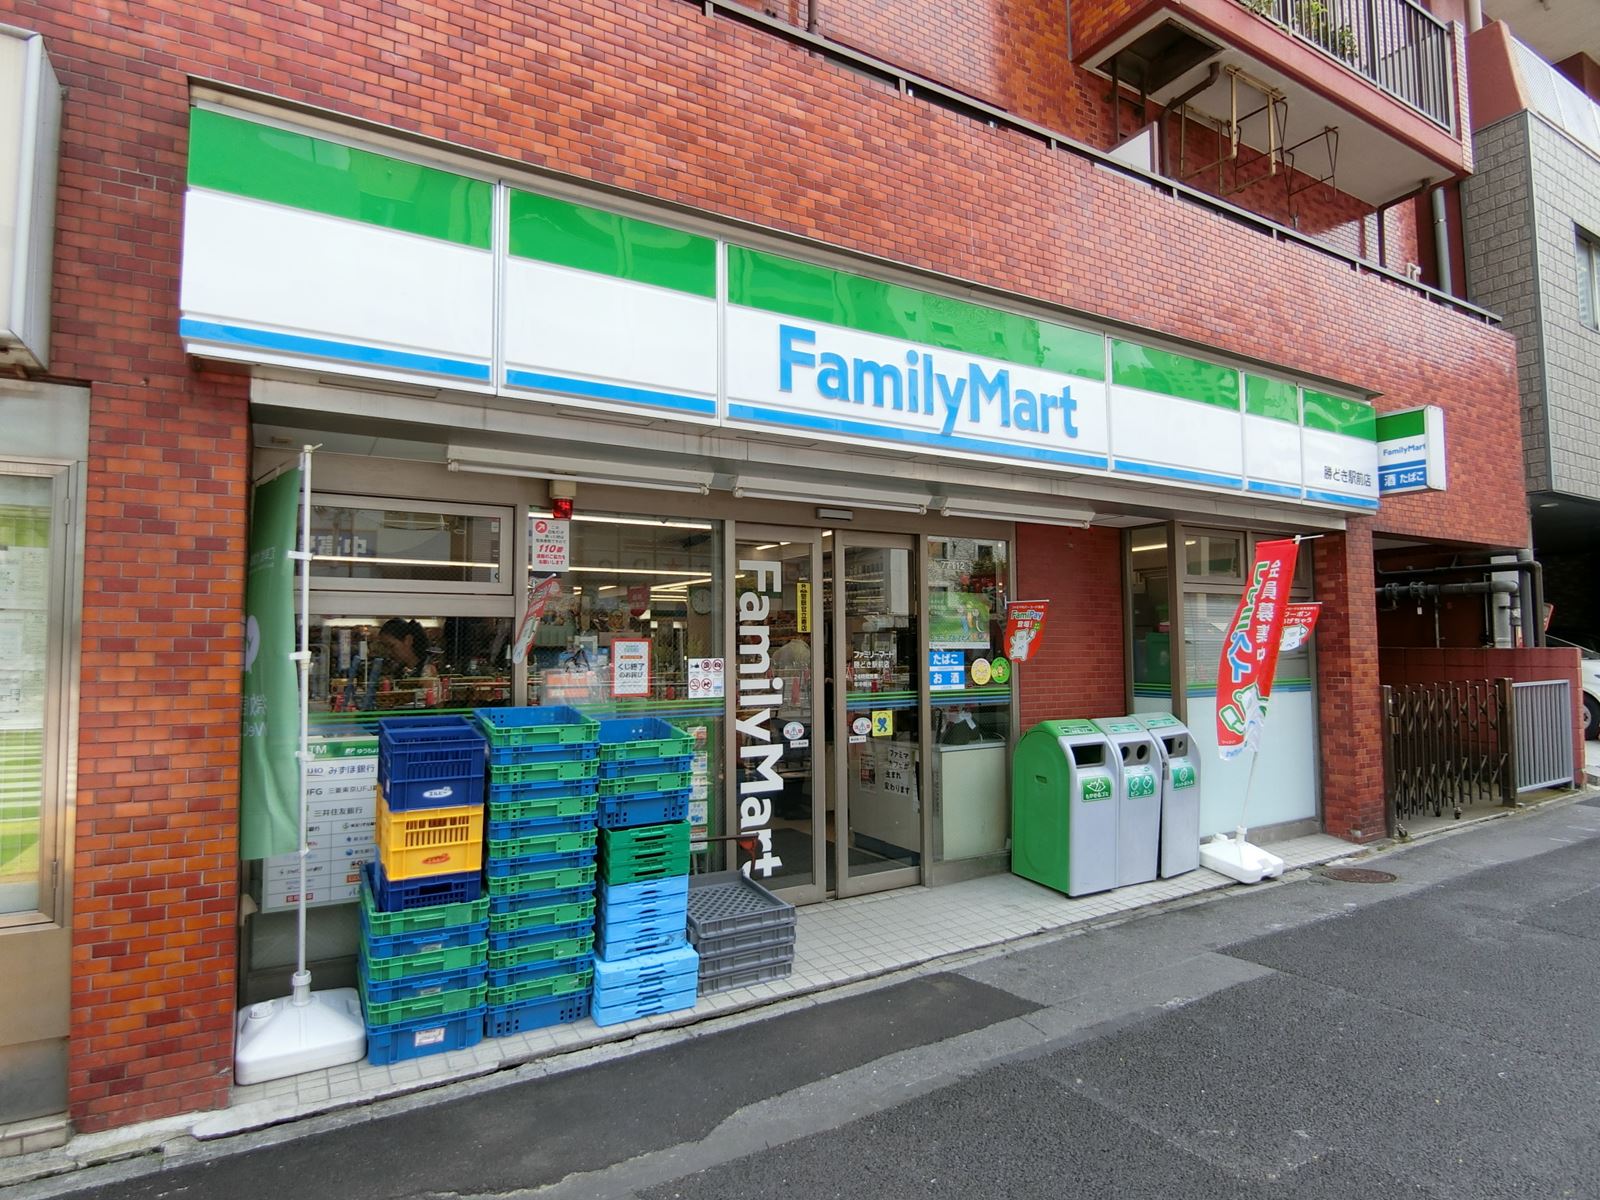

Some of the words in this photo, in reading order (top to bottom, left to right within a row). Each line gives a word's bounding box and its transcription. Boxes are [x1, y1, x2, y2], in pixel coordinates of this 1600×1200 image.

[778, 323, 1078, 438] FamilyMart
[1383, 443, 1426, 456] FamilyMart
[1324, 465, 1371, 487] 勝どき駅前店
[1384, 473, 1397, 487] 酒
[1400, 471, 1424, 484] たばこ
[1010, 609, 1044, 621] FamiPay
[1256, 559, 1282, 663] 会員募集中
[1227, 561, 1270, 683] ファミペイ
[853, 650, 894, 659] ファミリーマート
[933, 653, 959, 665] たばこ
[617, 662, 645, 671] くじ終了
[933, 673, 943, 684] お
[736, 559, 784, 878] FamilyMart
[328, 764, 375, 775] みずほ銀行
[884, 782, 910, 795] 変わります
[314, 806, 363, 817] 三井住友銀行
